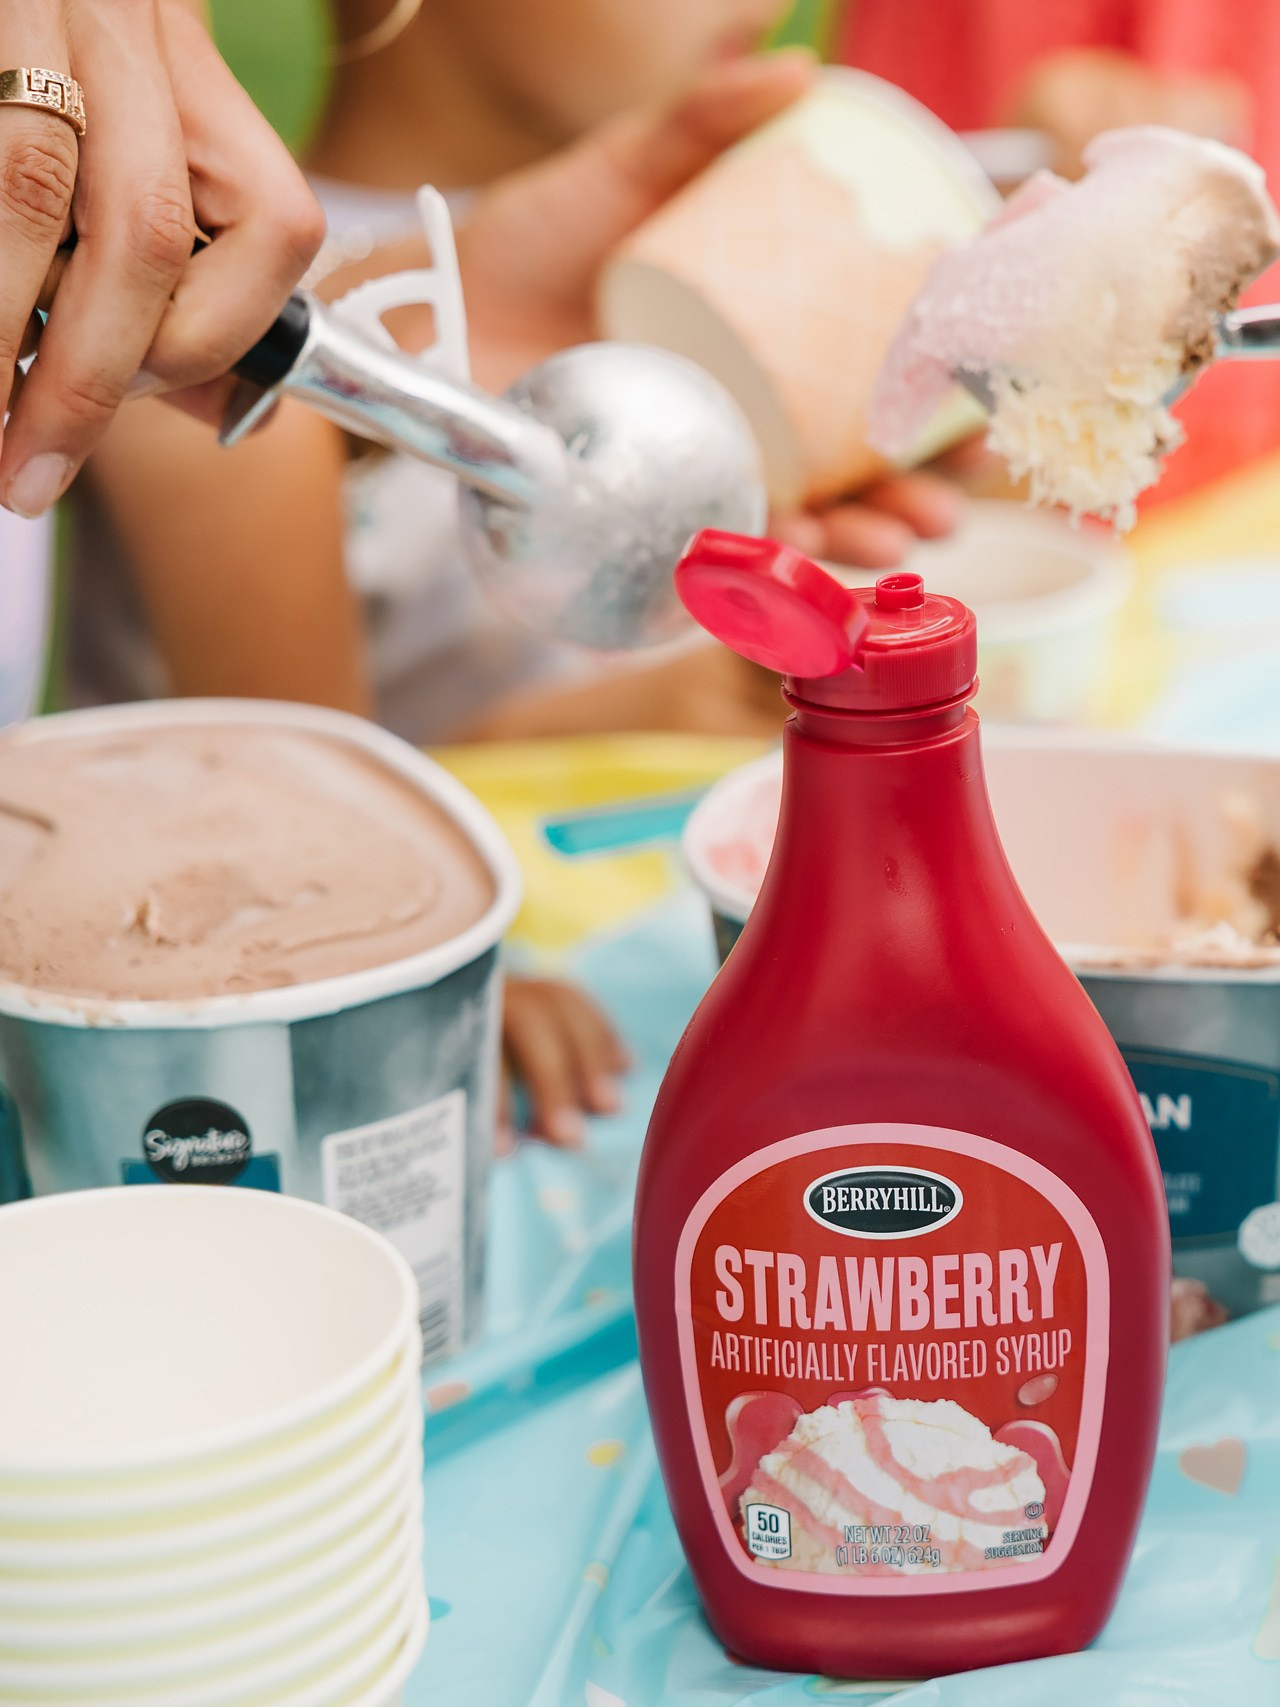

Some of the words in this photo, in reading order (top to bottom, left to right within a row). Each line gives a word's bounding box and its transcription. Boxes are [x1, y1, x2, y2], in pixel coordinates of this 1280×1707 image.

[822, 1185, 944, 1214] BERRYHILL
[714, 1242, 1064, 1332] STRAWBERRY
[711, 1331, 858, 1382] ARTIFICIALLY
[867, 1339, 988, 1382] FLAVORED
[996, 1328, 1072, 1378] SYRUP
[758, 1511, 779, 1533] 50
[752, 1531, 788, 1545] CALORIES
[844, 1525, 867, 1543] NET
[870, 1525, 892, 1543] WT
[894, 1525, 910, 1543] 22
[913, 1524, 931, 1542] OZ
[1002, 1527, 1044, 1544] SERVING
[836, 1545, 848, 1567] (1
[852, 1546, 868, 1564] LB
[870, 1546, 879, 1564] 6
[881, 1545, 906, 1567] OZ)
[908, 1545, 941, 1567] 624g
[984, 1541, 1045, 1560] SUGGESTION
